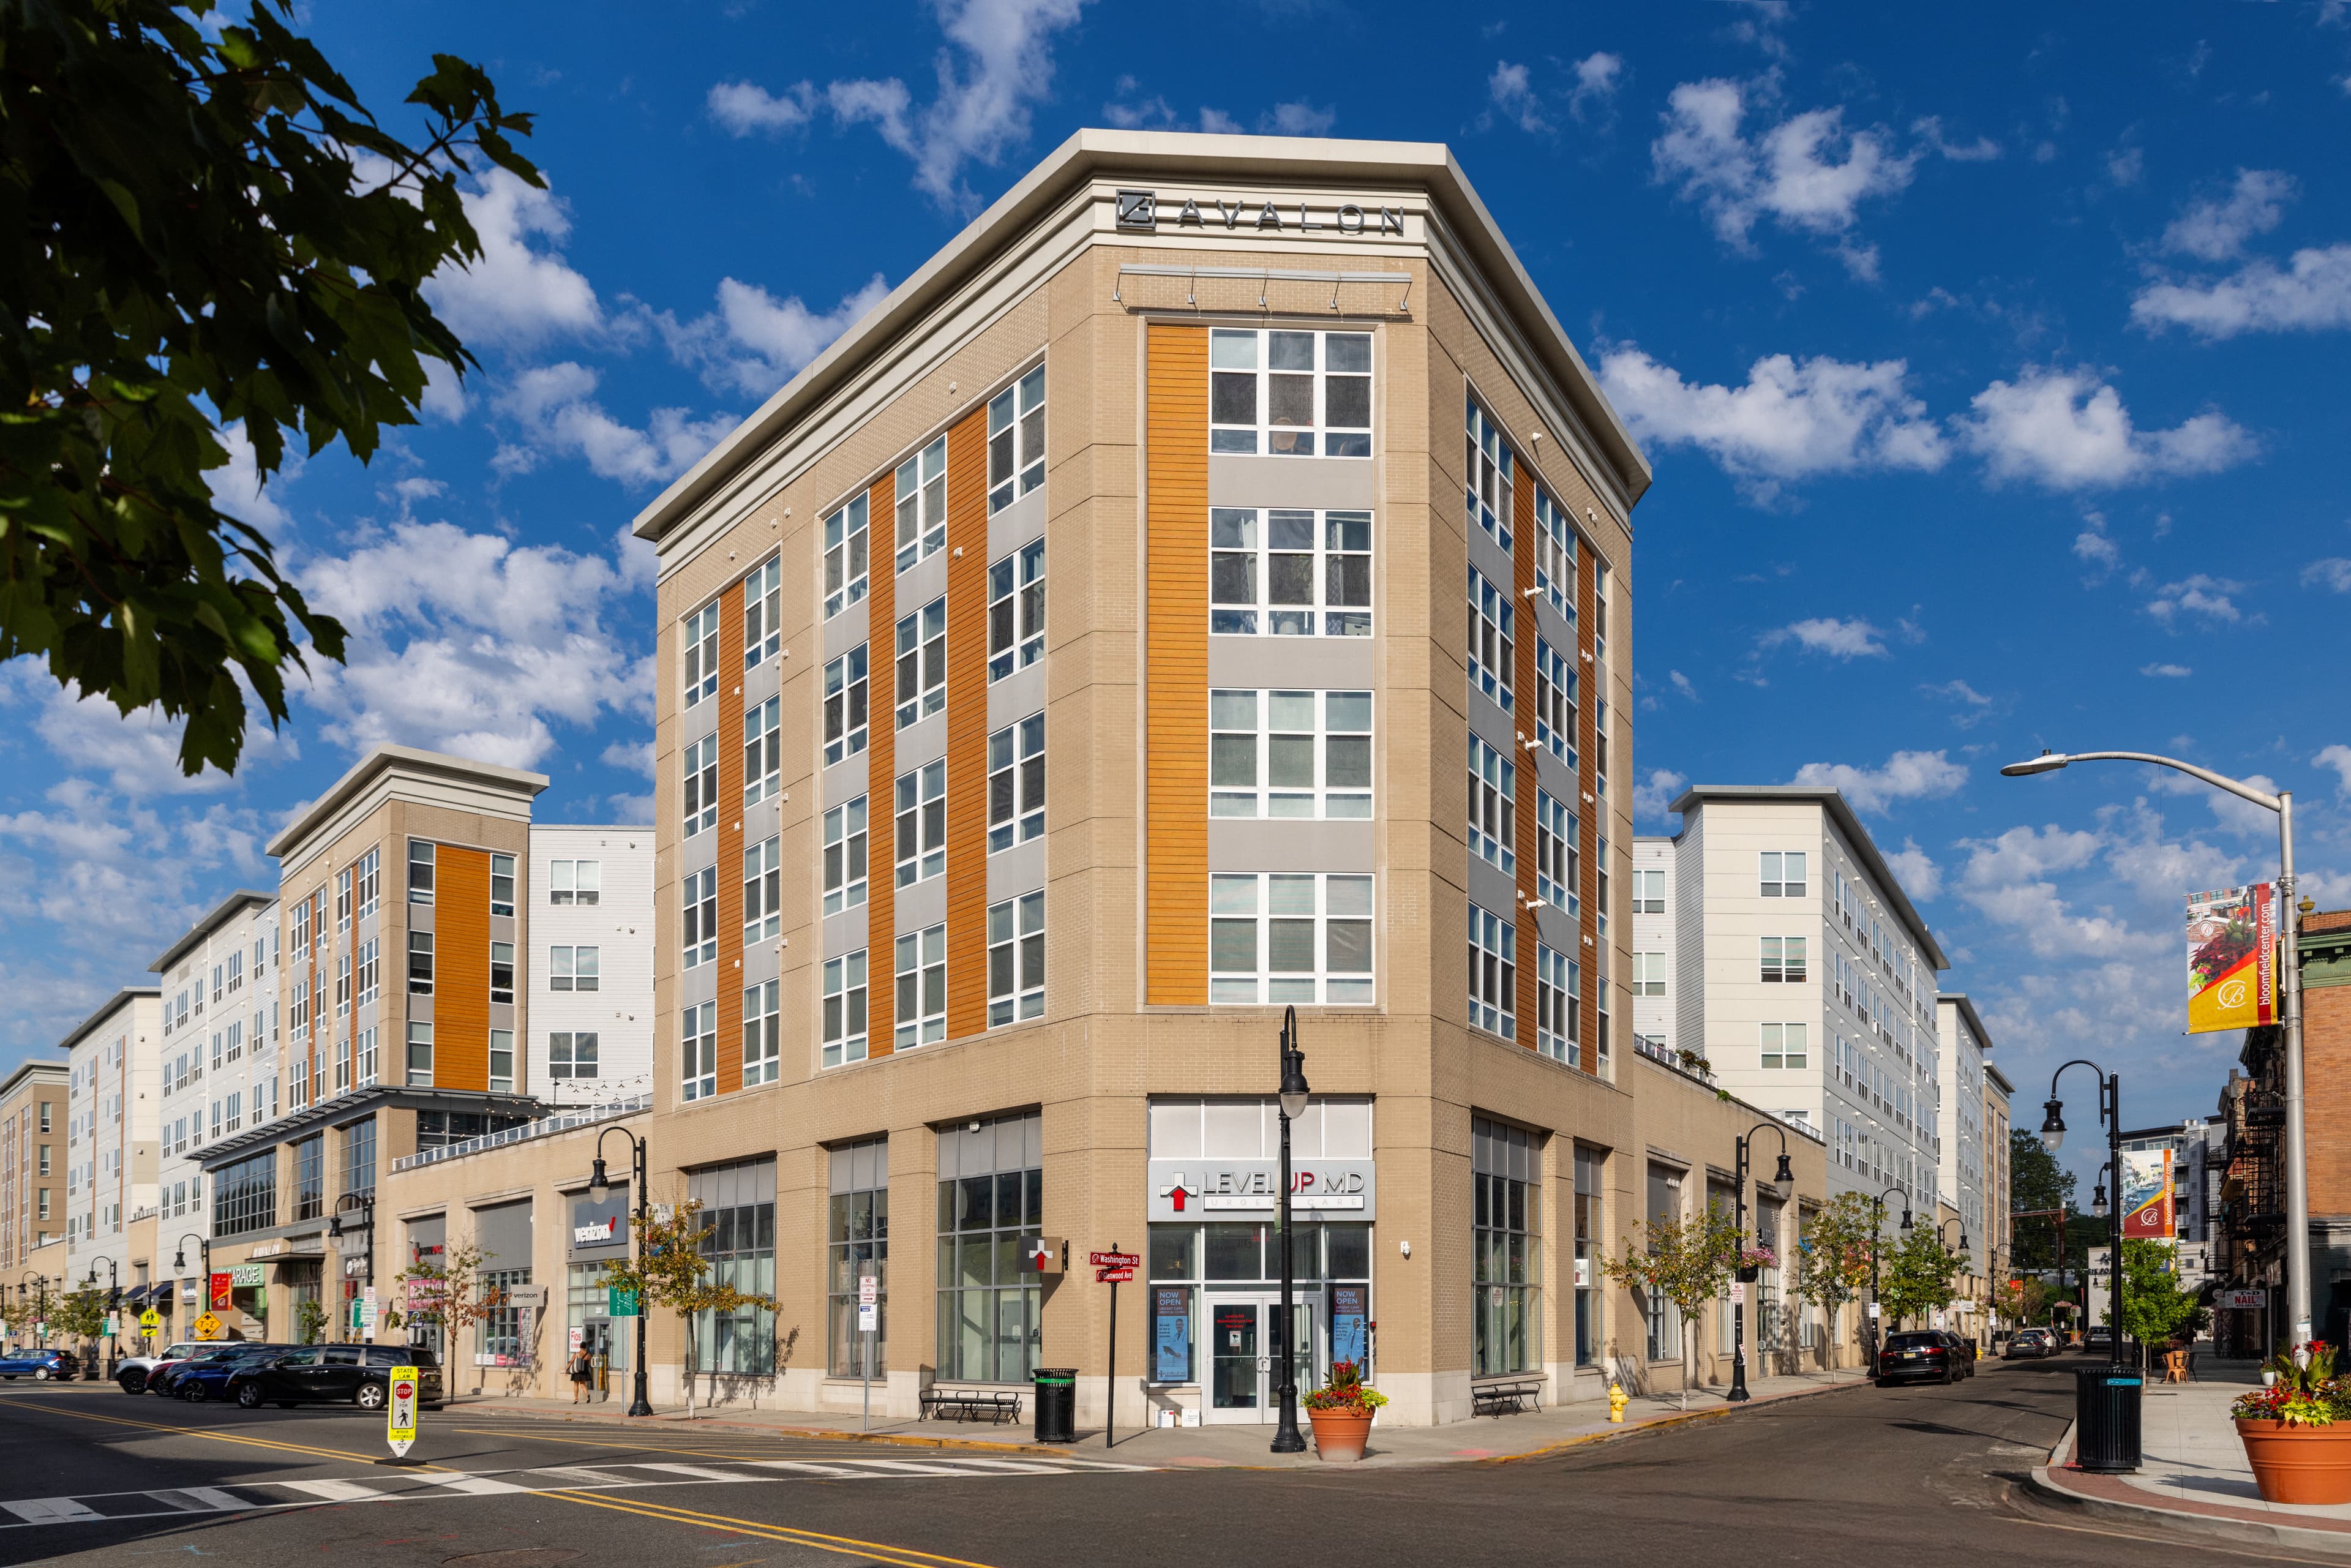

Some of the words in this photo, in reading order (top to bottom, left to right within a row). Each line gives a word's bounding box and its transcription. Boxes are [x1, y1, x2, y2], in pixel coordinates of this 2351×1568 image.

[1176, 198, 1404, 231] AVALON
[2259, 903, 2270, 1005] bloomfieldcenter.com
[1322, 1172, 1364, 1193] MD
[574, 1221, 611, 1243] verizon
[1100, 1255, 1131, 1266] Washington
[1131, 1256, 1138, 1265] St
[1103, 1271, 1124, 1280] Glenwood
[2235, 1295, 2256, 1304] NAIL
[571, 1330, 581, 1341] Fios
